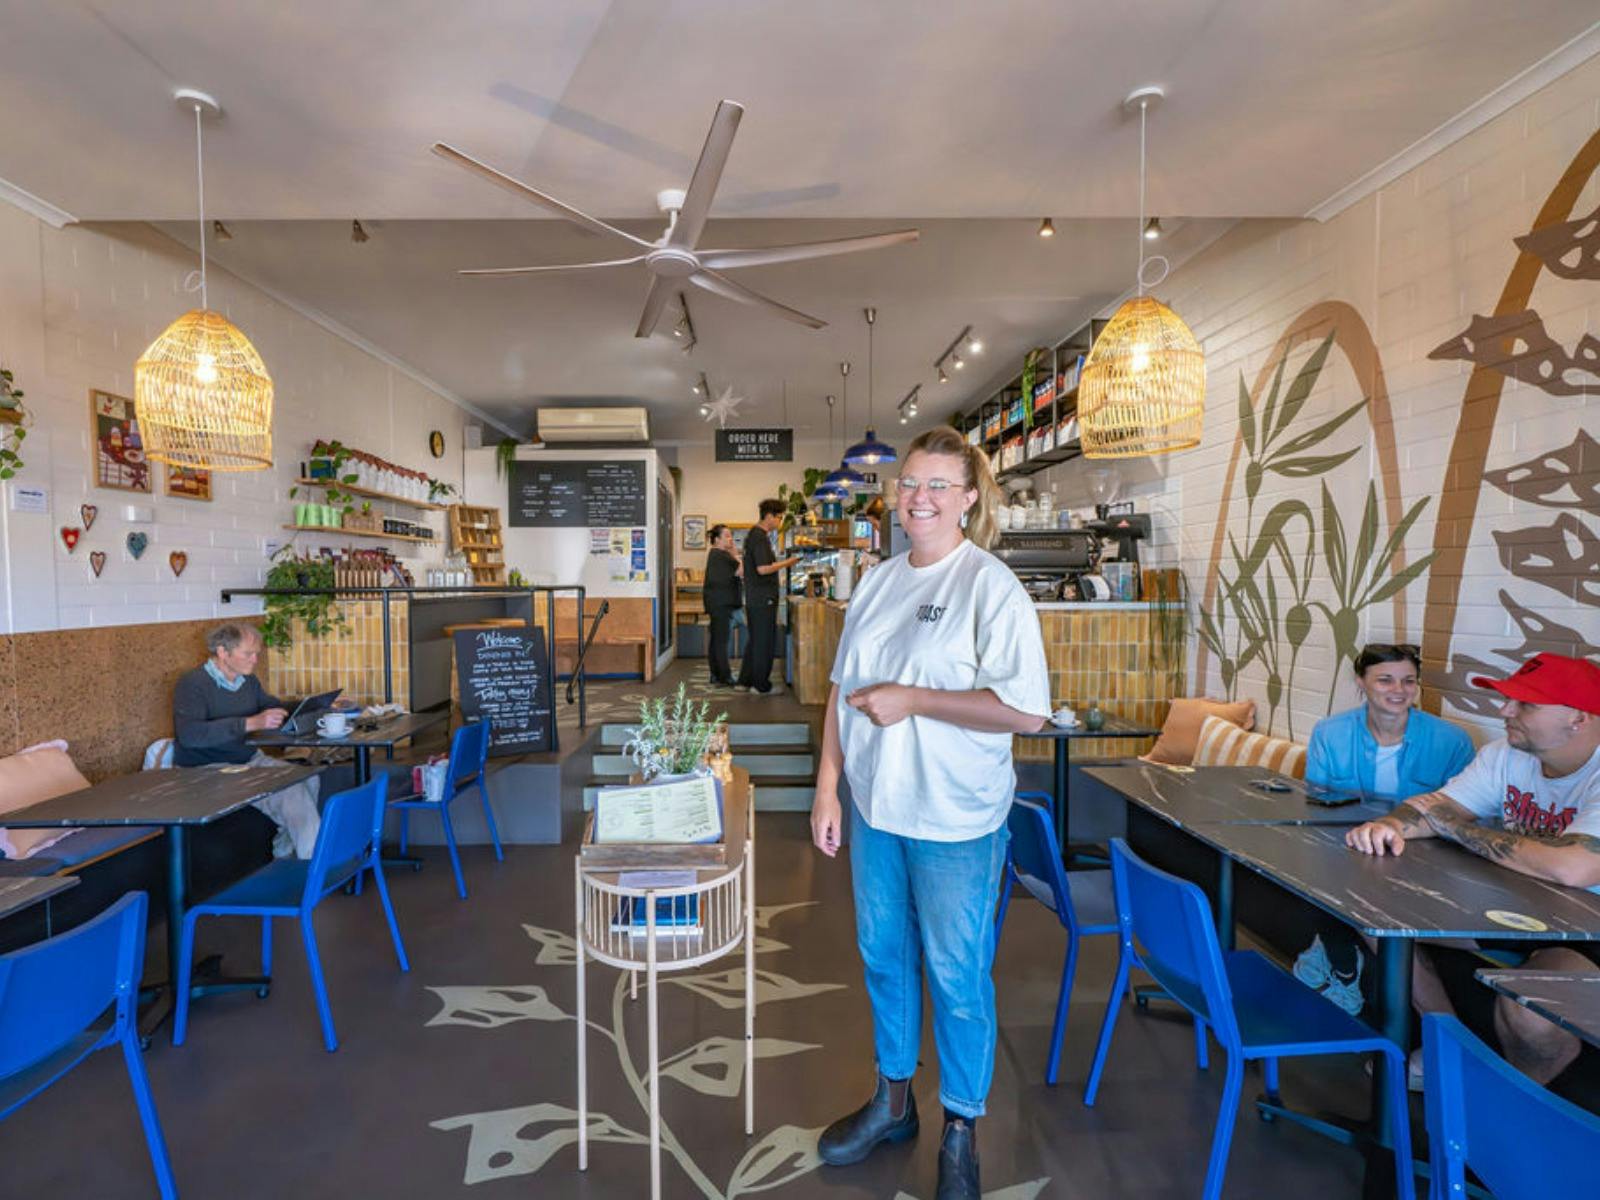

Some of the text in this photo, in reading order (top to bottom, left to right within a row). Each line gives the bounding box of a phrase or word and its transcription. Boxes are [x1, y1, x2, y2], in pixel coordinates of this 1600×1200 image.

[728, 433, 779, 444] ORDER HERE
[738, 444, 770, 454] WITH US
